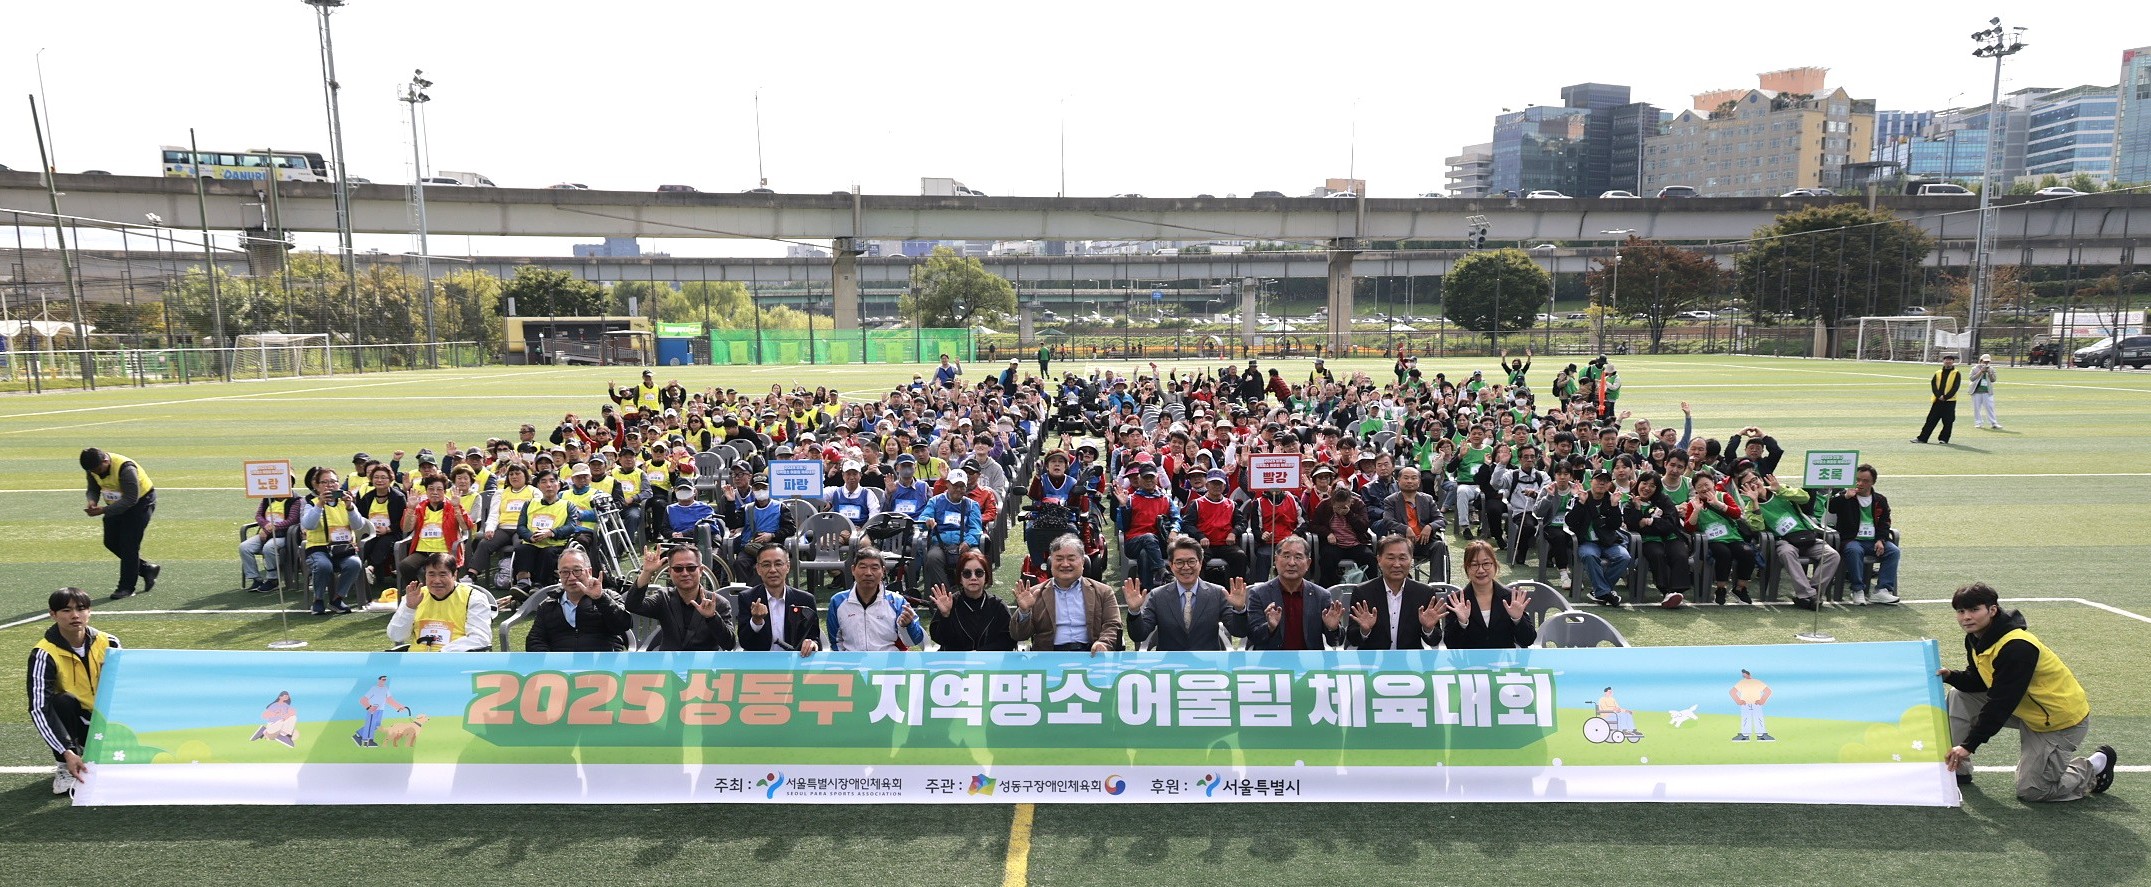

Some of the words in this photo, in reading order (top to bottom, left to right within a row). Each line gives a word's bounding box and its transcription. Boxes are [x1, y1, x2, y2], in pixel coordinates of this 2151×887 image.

[1263, 471, 1288, 484] 빨강
[1818, 467, 1843, 480] 초록
[257, 478, 279, 490] 노랑
[783, 478, 809, 491] 파랑
[467, 673, 667, 726] 2025
[679, 673, 855, 726] 성동구
[869, 673, 1104, 727] 지역명소
[1117, 673, 1293, 728] 어울림
[1308, 672, 1553, 728] 체육대회
[714, 777, 743, 793] 주최
[786, 777, 902, 791] 서울특별시장애인체육회
[925, 779, 955, 794] 주관
[998, 779, 1103, 794] 성동구장애인체육회
[1150, 778, 1179, 795] 후원
[1222, 778, 1301, 796] 서울특별시
